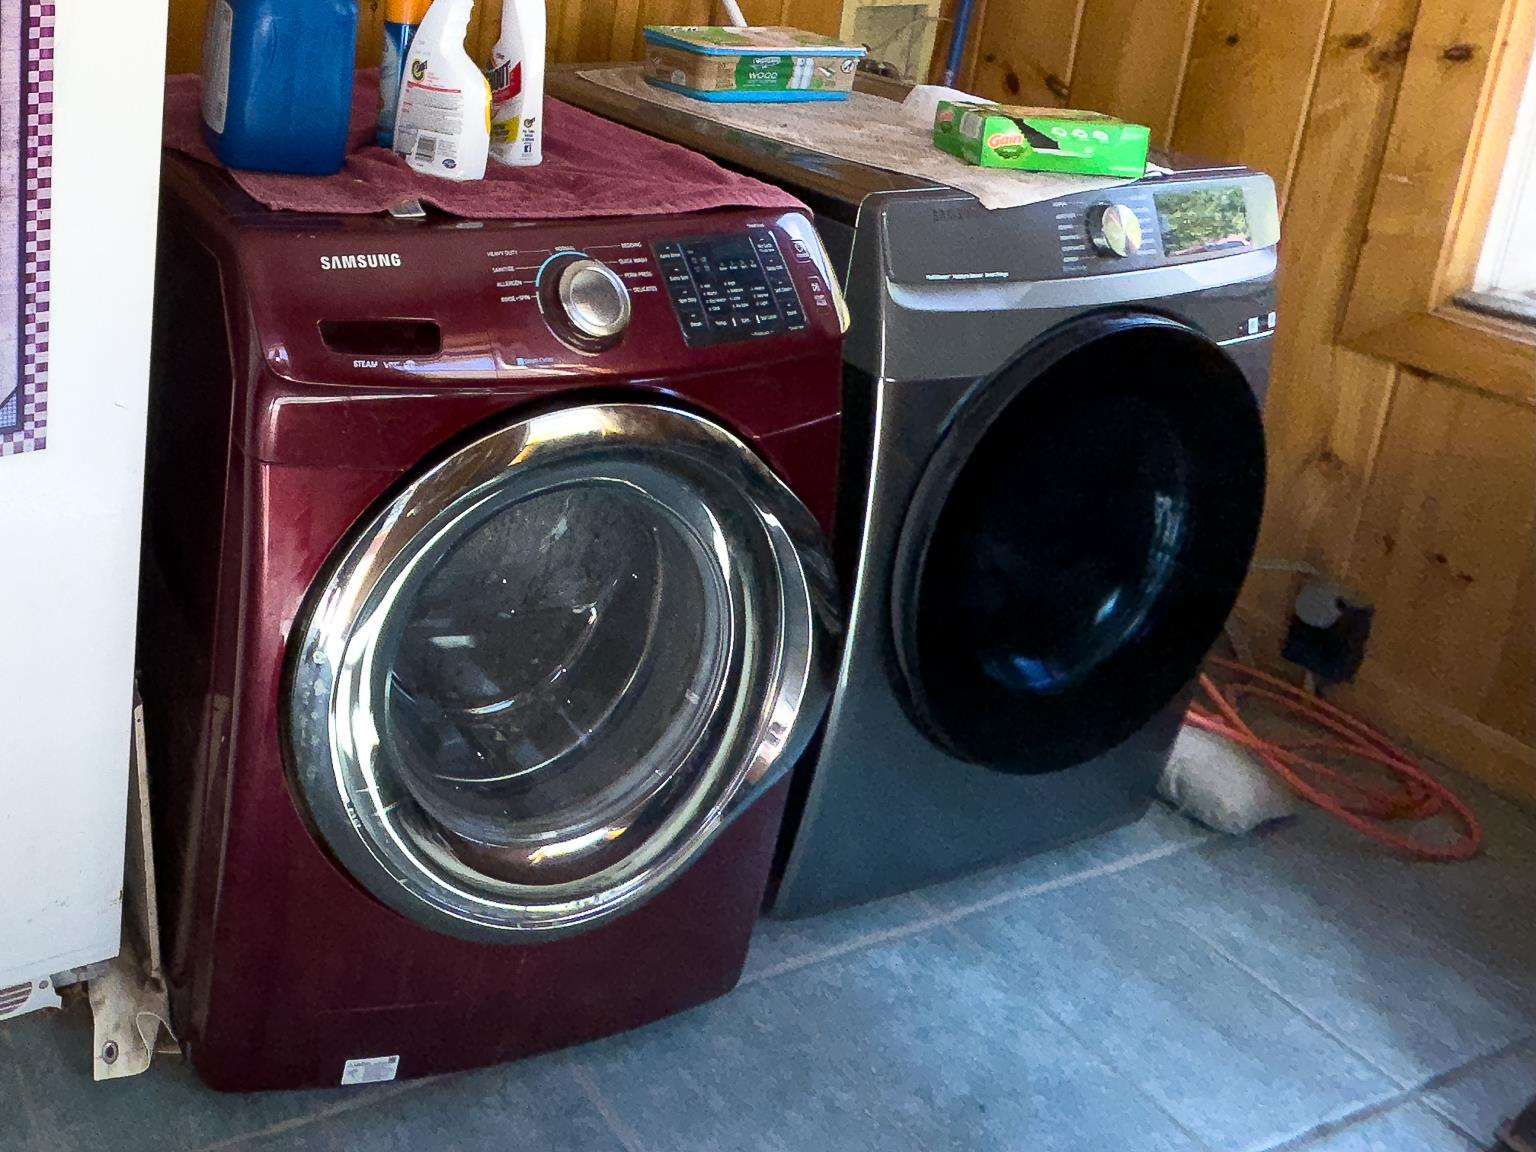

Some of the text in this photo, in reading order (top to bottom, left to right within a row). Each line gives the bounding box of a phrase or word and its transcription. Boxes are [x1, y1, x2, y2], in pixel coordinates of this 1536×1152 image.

[748, 71, 778, 80] WOOD
[988, 133, 1024, 148] Gain
[320, 253, 402, 270] SAMSUNG
[353, 360, 378, 369] STEAM
